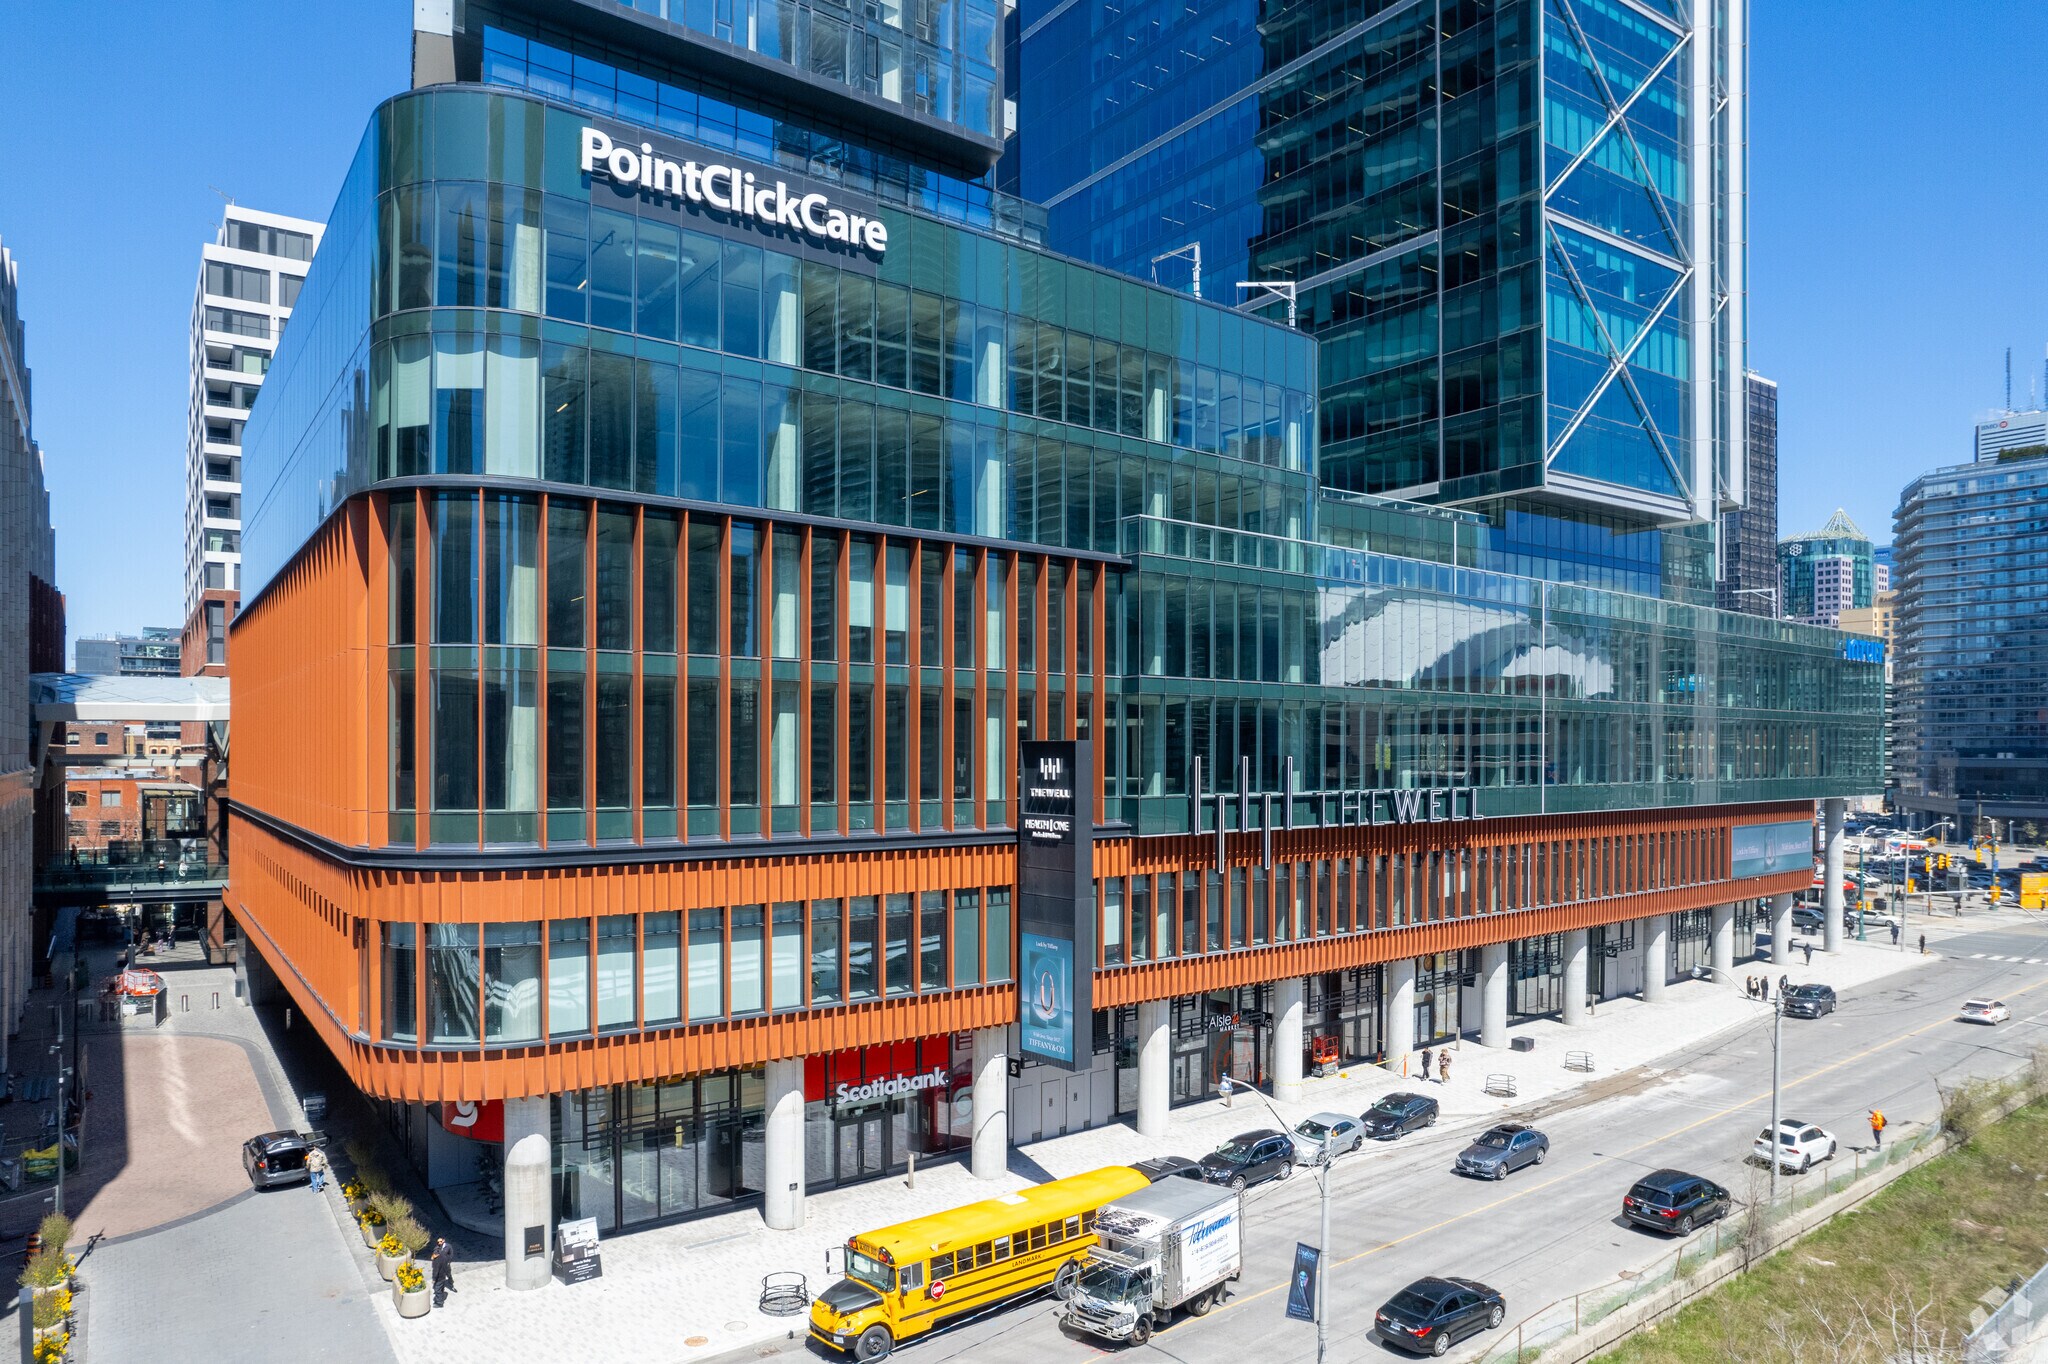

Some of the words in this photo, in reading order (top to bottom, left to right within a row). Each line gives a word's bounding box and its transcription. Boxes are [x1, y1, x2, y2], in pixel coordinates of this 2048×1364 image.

[581, 126, 888, 252] PointClickCare
[1220, 1024, 1240, 1032] MARKET
[837, 1067, 946, 1104] Scotiabank
[1012, 1254, 1042, 1267] LANDMARK
